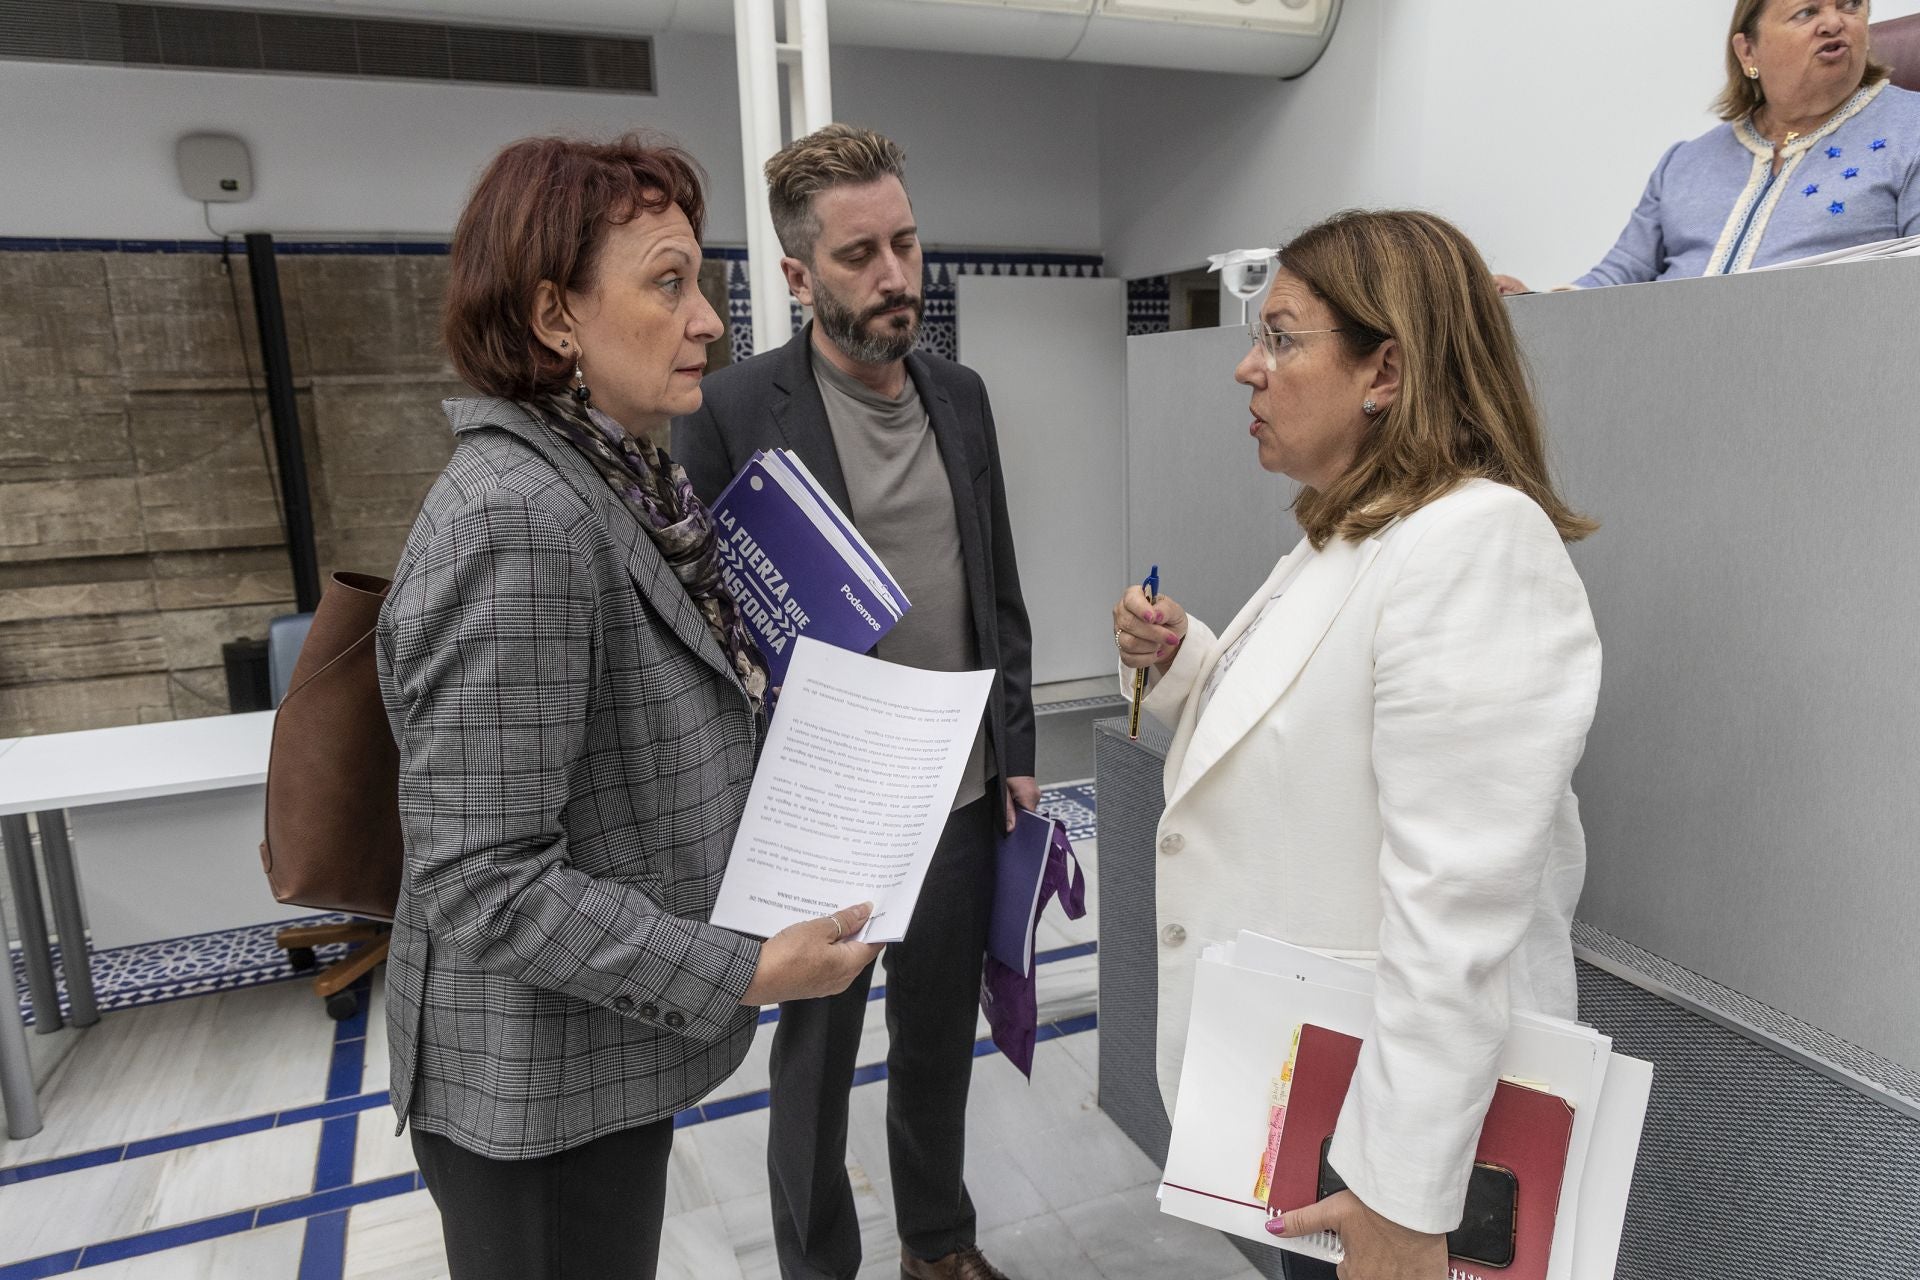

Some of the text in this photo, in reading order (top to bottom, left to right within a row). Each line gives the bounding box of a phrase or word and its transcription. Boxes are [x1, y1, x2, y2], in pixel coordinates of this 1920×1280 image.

[719, 509, 736, 531] LA
[730, 527, 790, 603] FUERZA
[783, 597, 811, 630] QUE
[840, 583, 881, 632] Podemos
